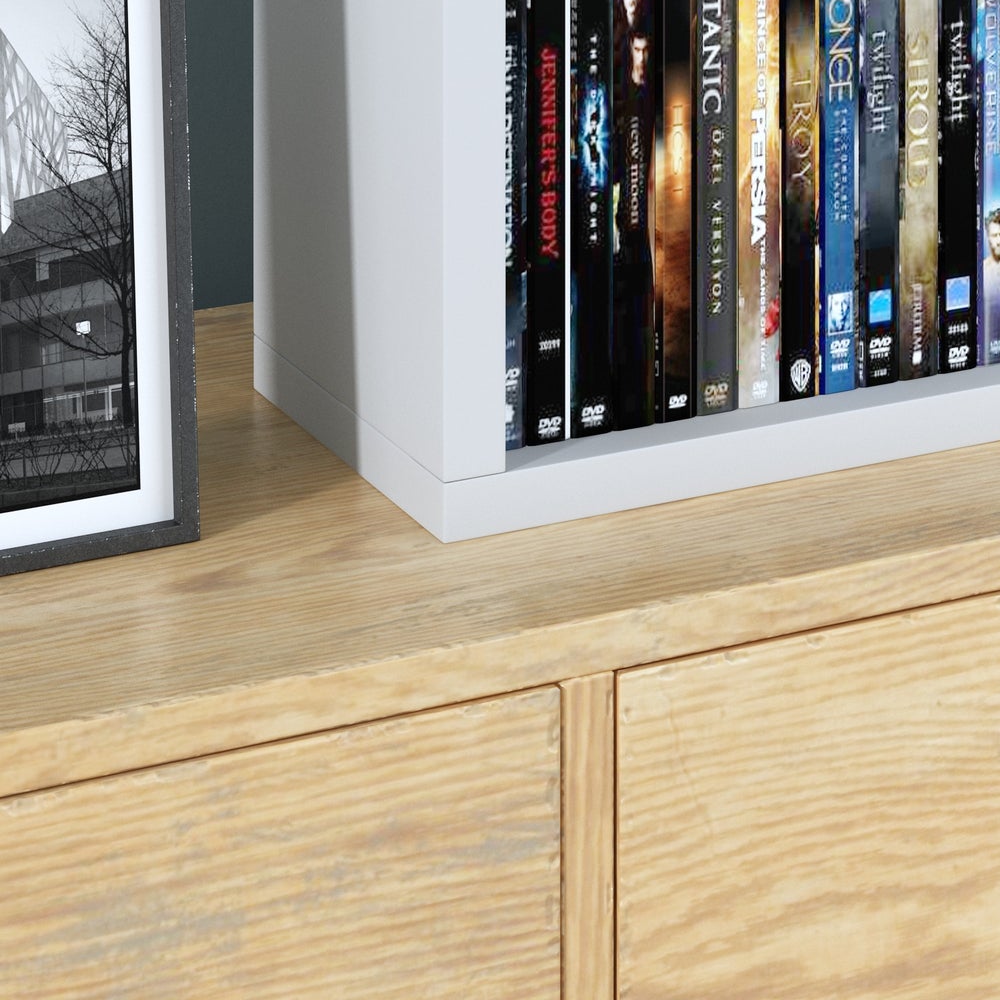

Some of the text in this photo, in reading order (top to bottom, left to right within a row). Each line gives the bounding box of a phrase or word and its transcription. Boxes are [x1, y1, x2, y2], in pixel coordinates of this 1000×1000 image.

[757, 72, 767, 105] OF
[867, 30, 894, 133] twilight
[945, 19, 971, 122] twilight
[541, 47, 558, 258] JENNIFER'S BODY
[790, 71, 813, 185] TROY
[631, 164, 640, 224] moon
[750, 108, 767, 245] PERSIA
[870, 337, 892, 348] DVD
[949, 346, 969, 357] DVD
[582, 404, 605, 416] DVD
[669, 394, 687, 405] DVD
